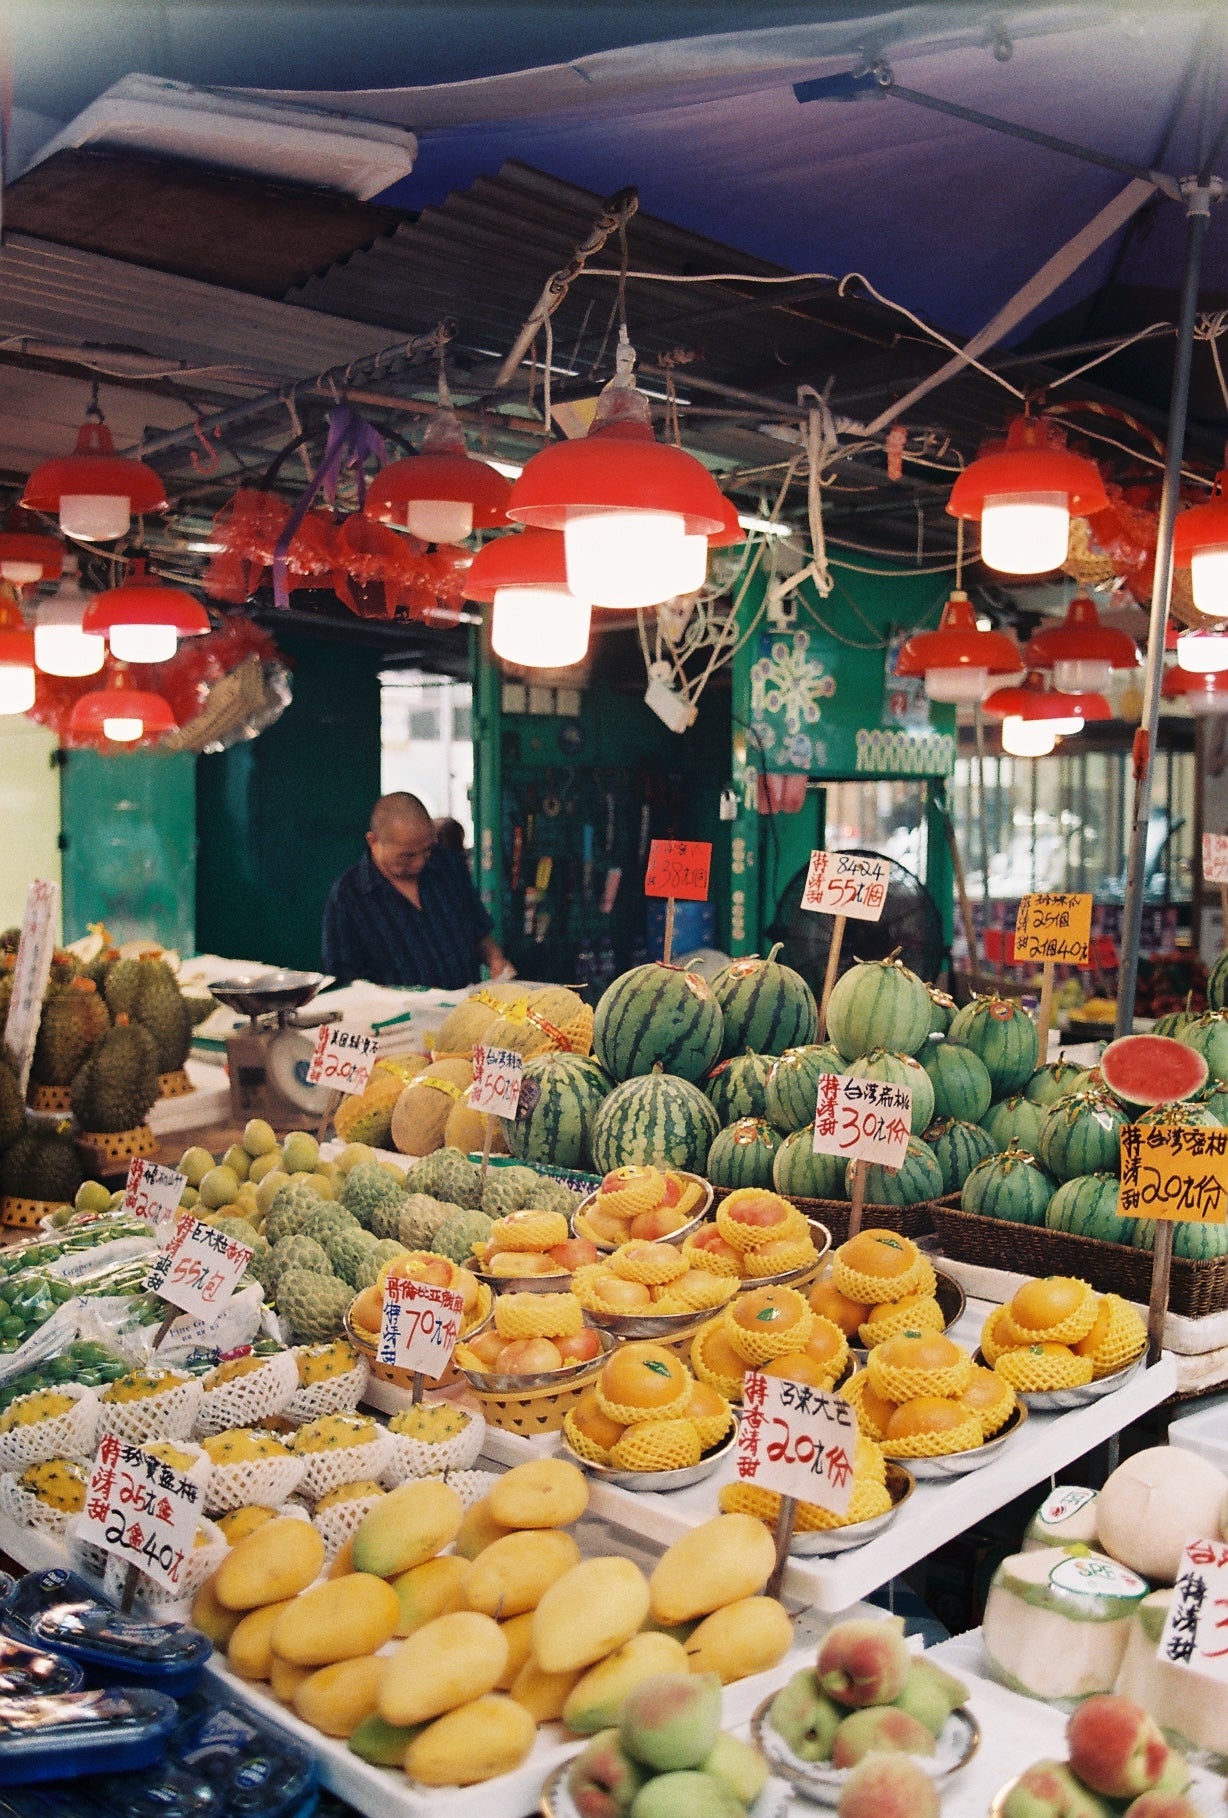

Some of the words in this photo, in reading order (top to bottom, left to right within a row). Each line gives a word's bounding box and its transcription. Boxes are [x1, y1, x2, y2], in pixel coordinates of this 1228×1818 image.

[837, 857, 885, 881] 8424
[840, 1107, 909, 1148] 30元份
[1142, 1166, 1228, 1218] 20元份
[405, 1310, 457, 1351] 70元份
[766, 1417, 854, 1488] 20元份
